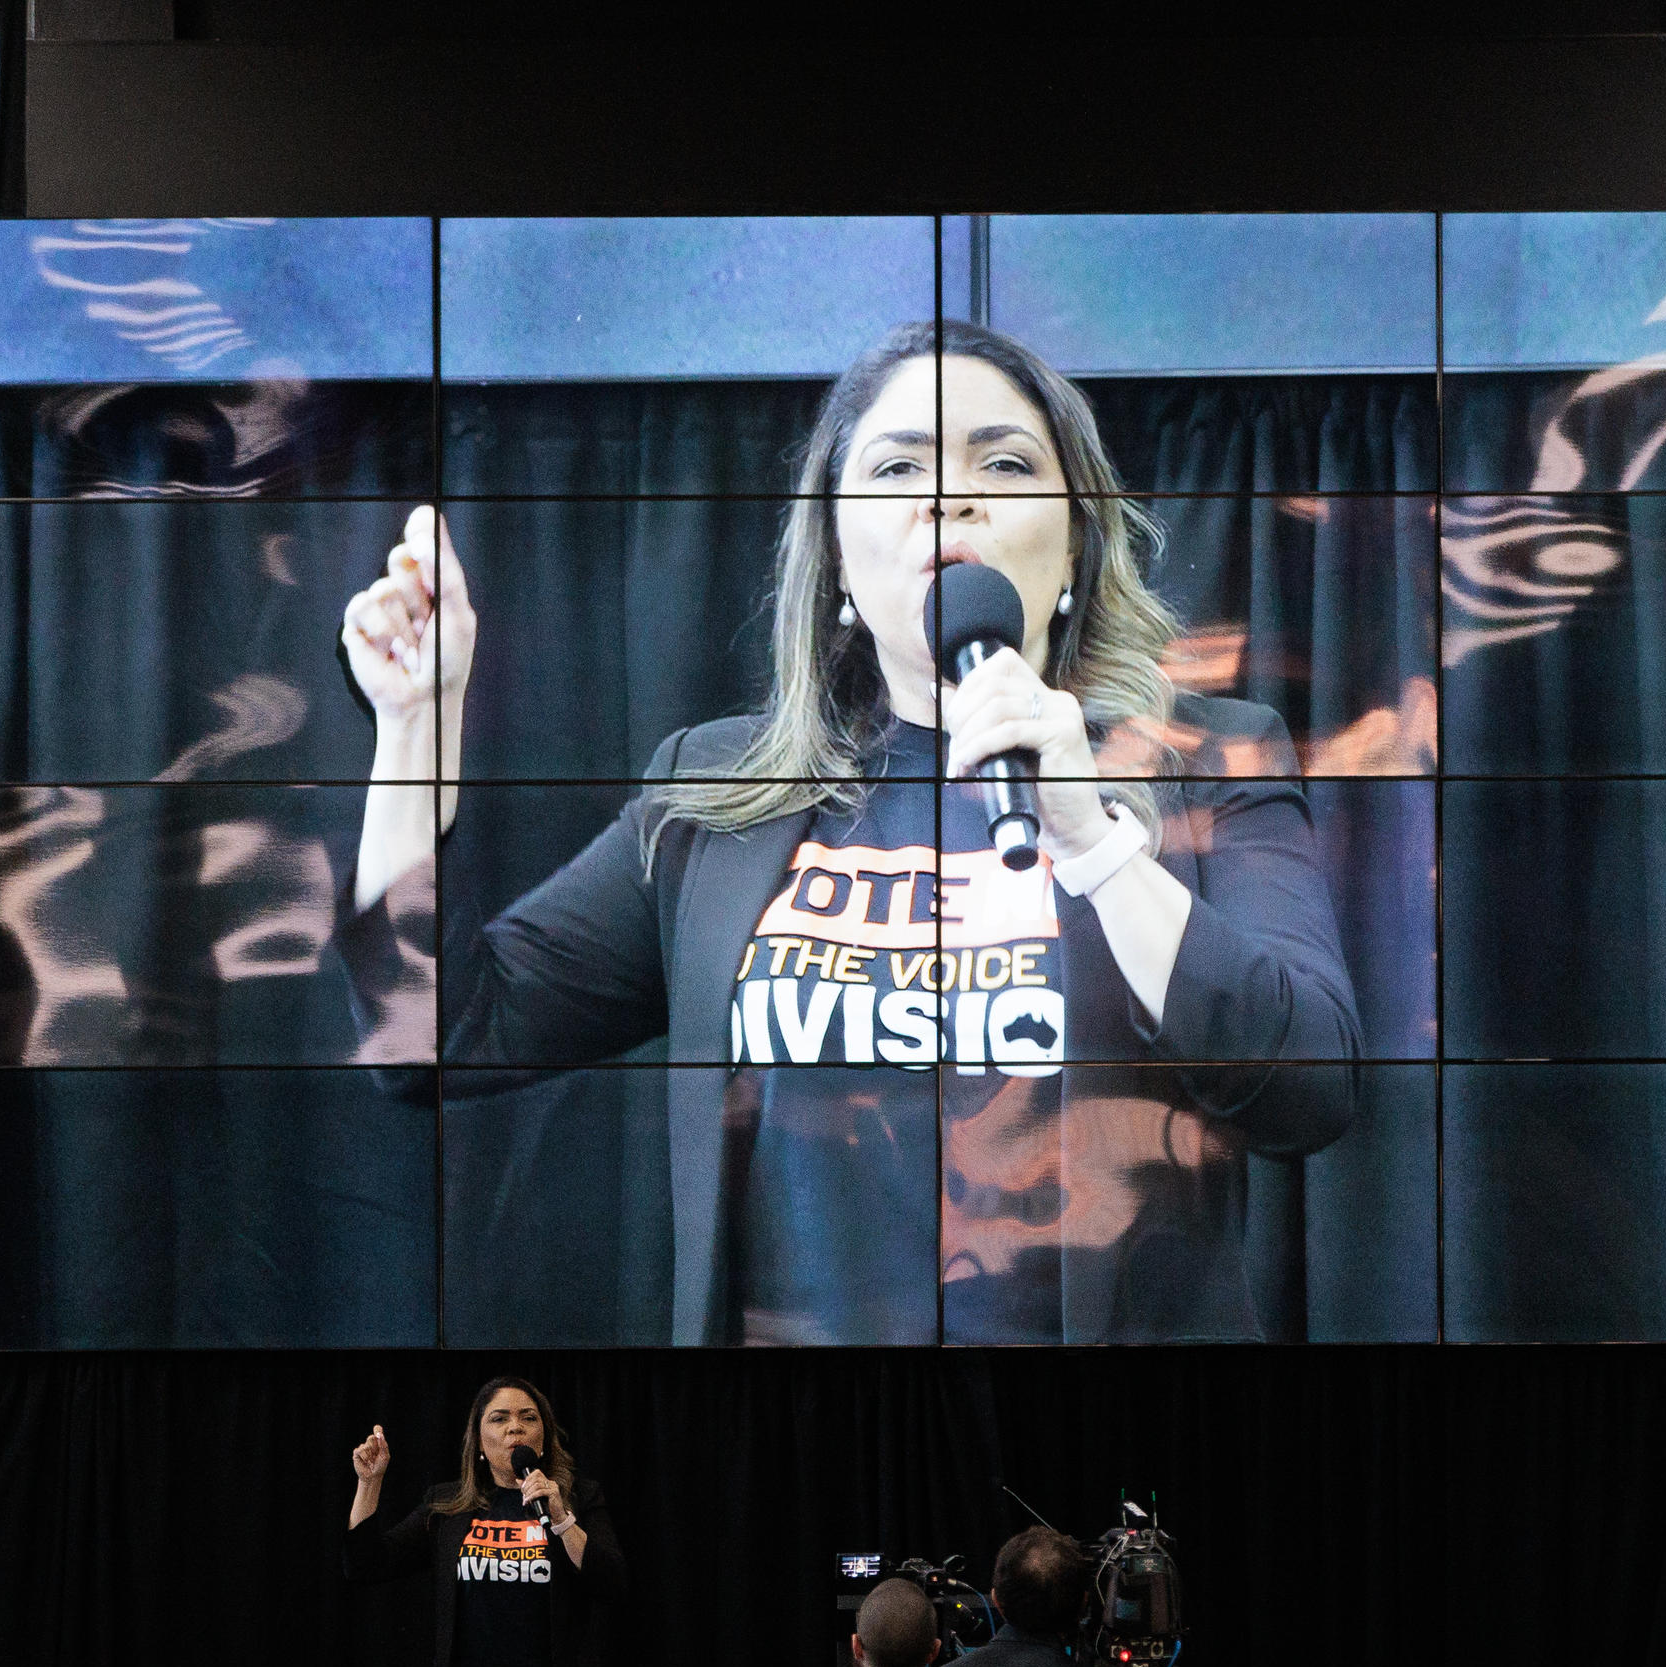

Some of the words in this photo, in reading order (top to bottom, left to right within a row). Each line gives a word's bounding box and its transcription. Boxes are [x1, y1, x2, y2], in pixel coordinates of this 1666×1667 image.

[768, 936, 876, 983] THE
[890, 943, 1048, 992] VOICE
[731, 977, 1065, 1078] IVISIO
[470, 1524, 522, 1543] OTE
[526, 1525, 548, 1543] N
[467, 1545, 497, 1558] THE
[500, 1547, 546, 1560] VOICE
[457, 1556, 551, 1584] IVISIO
